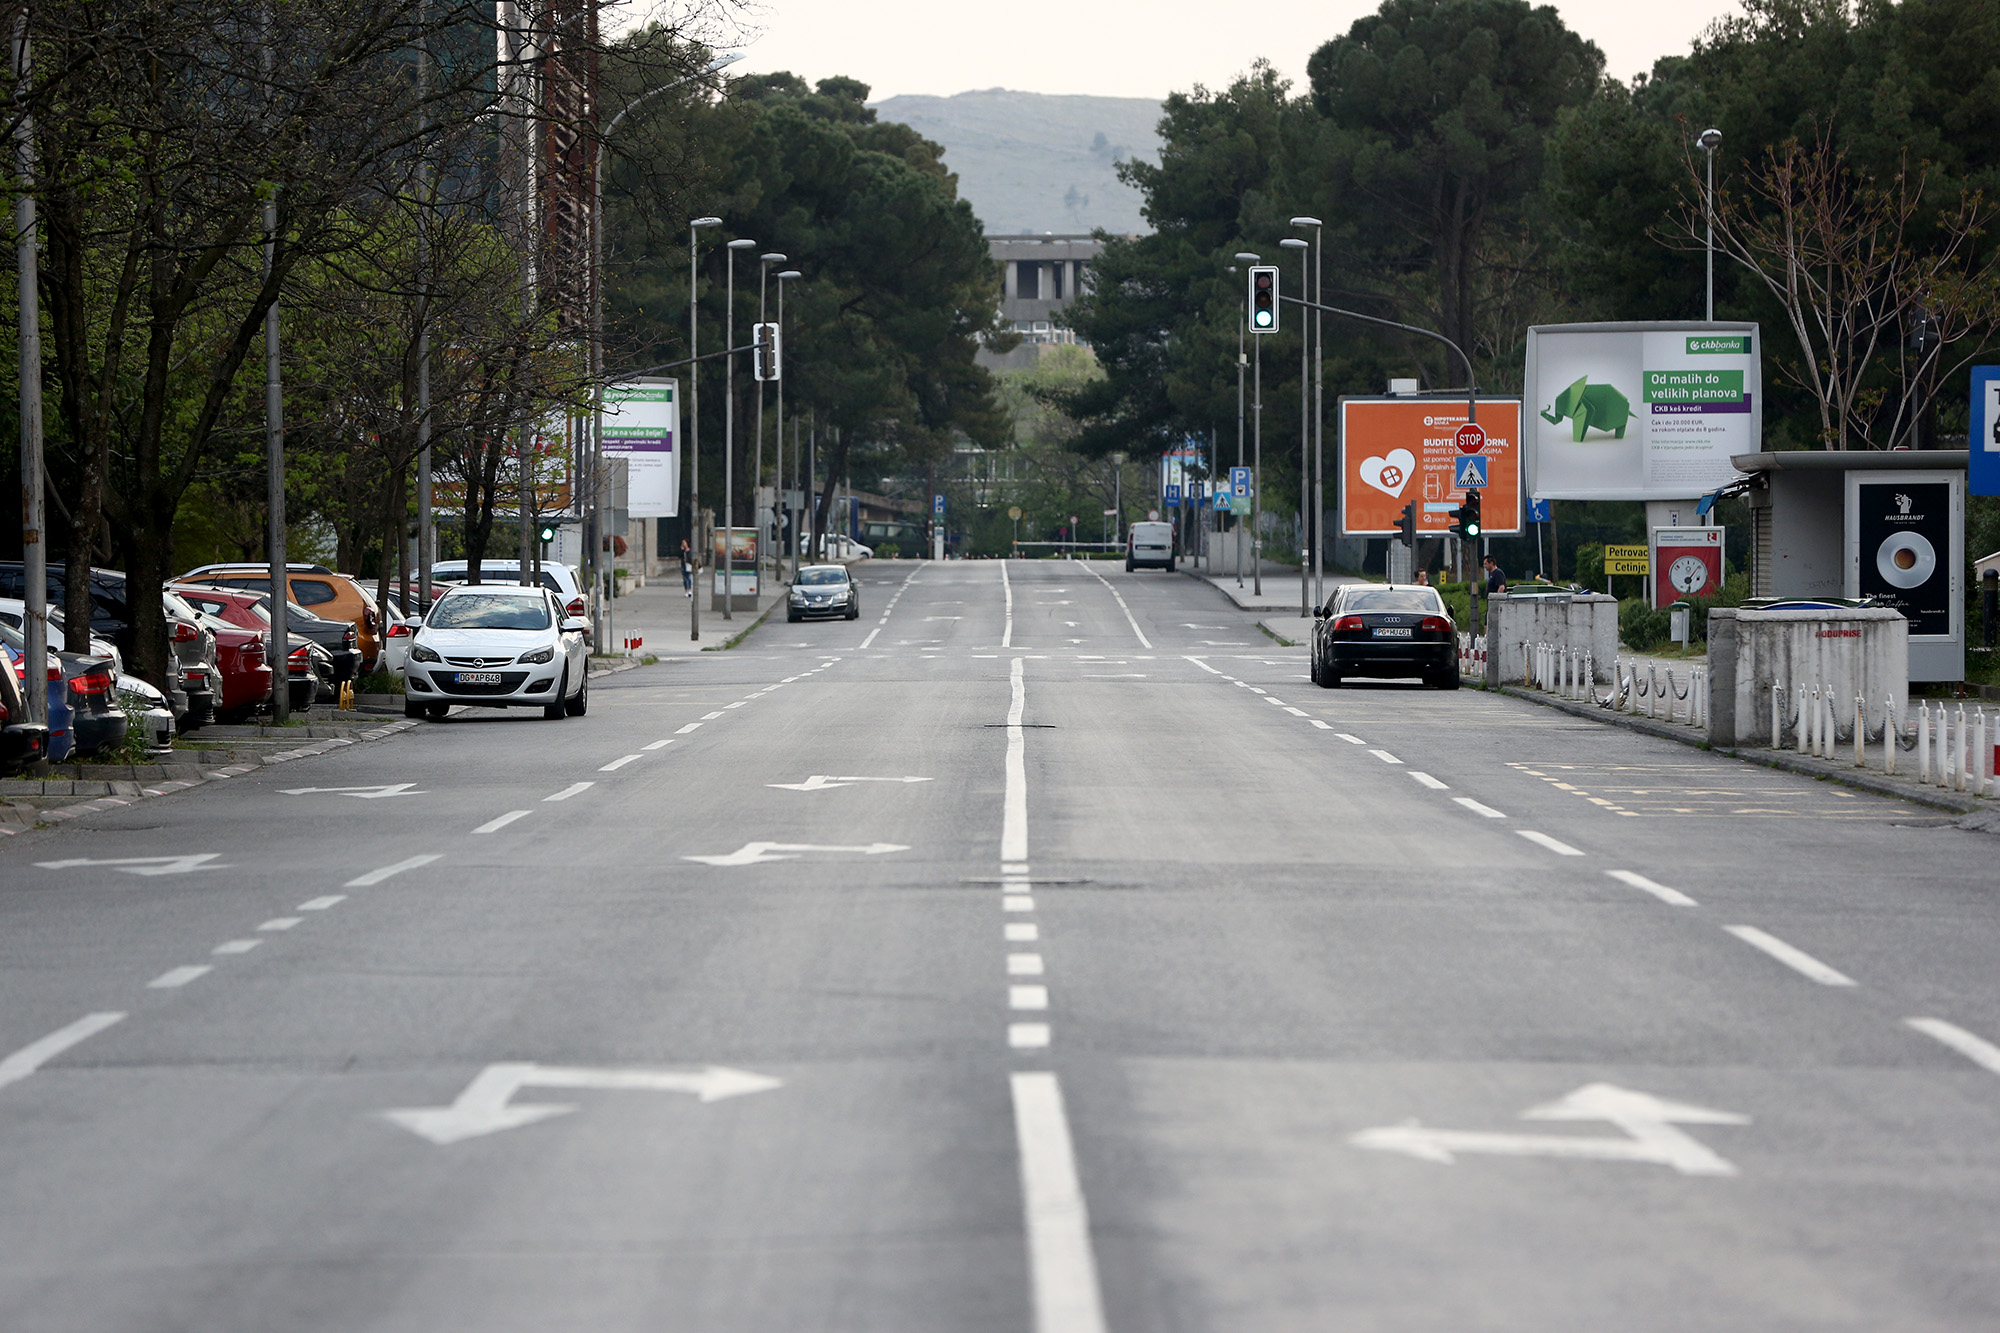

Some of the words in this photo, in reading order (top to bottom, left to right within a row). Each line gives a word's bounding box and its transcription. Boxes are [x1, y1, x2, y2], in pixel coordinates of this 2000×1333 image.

[1651, 373, 1666, 384] Od
[1670, 373, 1702, 384] malih
[1705, 373, 1719, 384] do
[1651, 388, 1689, 399] velikih
[1692, 387, 1737, 400] planova
[1423, 438, 1454, 447] BUDITE
[1459, 433, 1482, 446] STOP
[1431, 456, 1452, 464] pomoć
[1423, 464, 1450, 472] digitalnih
[1235, 470, 1246, 484] P
[1168, 486, 1178, 498] H
[935, 495, 944, 505] P
[1609, 547, 1648, 557] Petrovac
[1615, 562, 1647, 574] Cetinje
[460, 673, 470, 682] DG
[474, 673, 500, 683] AP648
